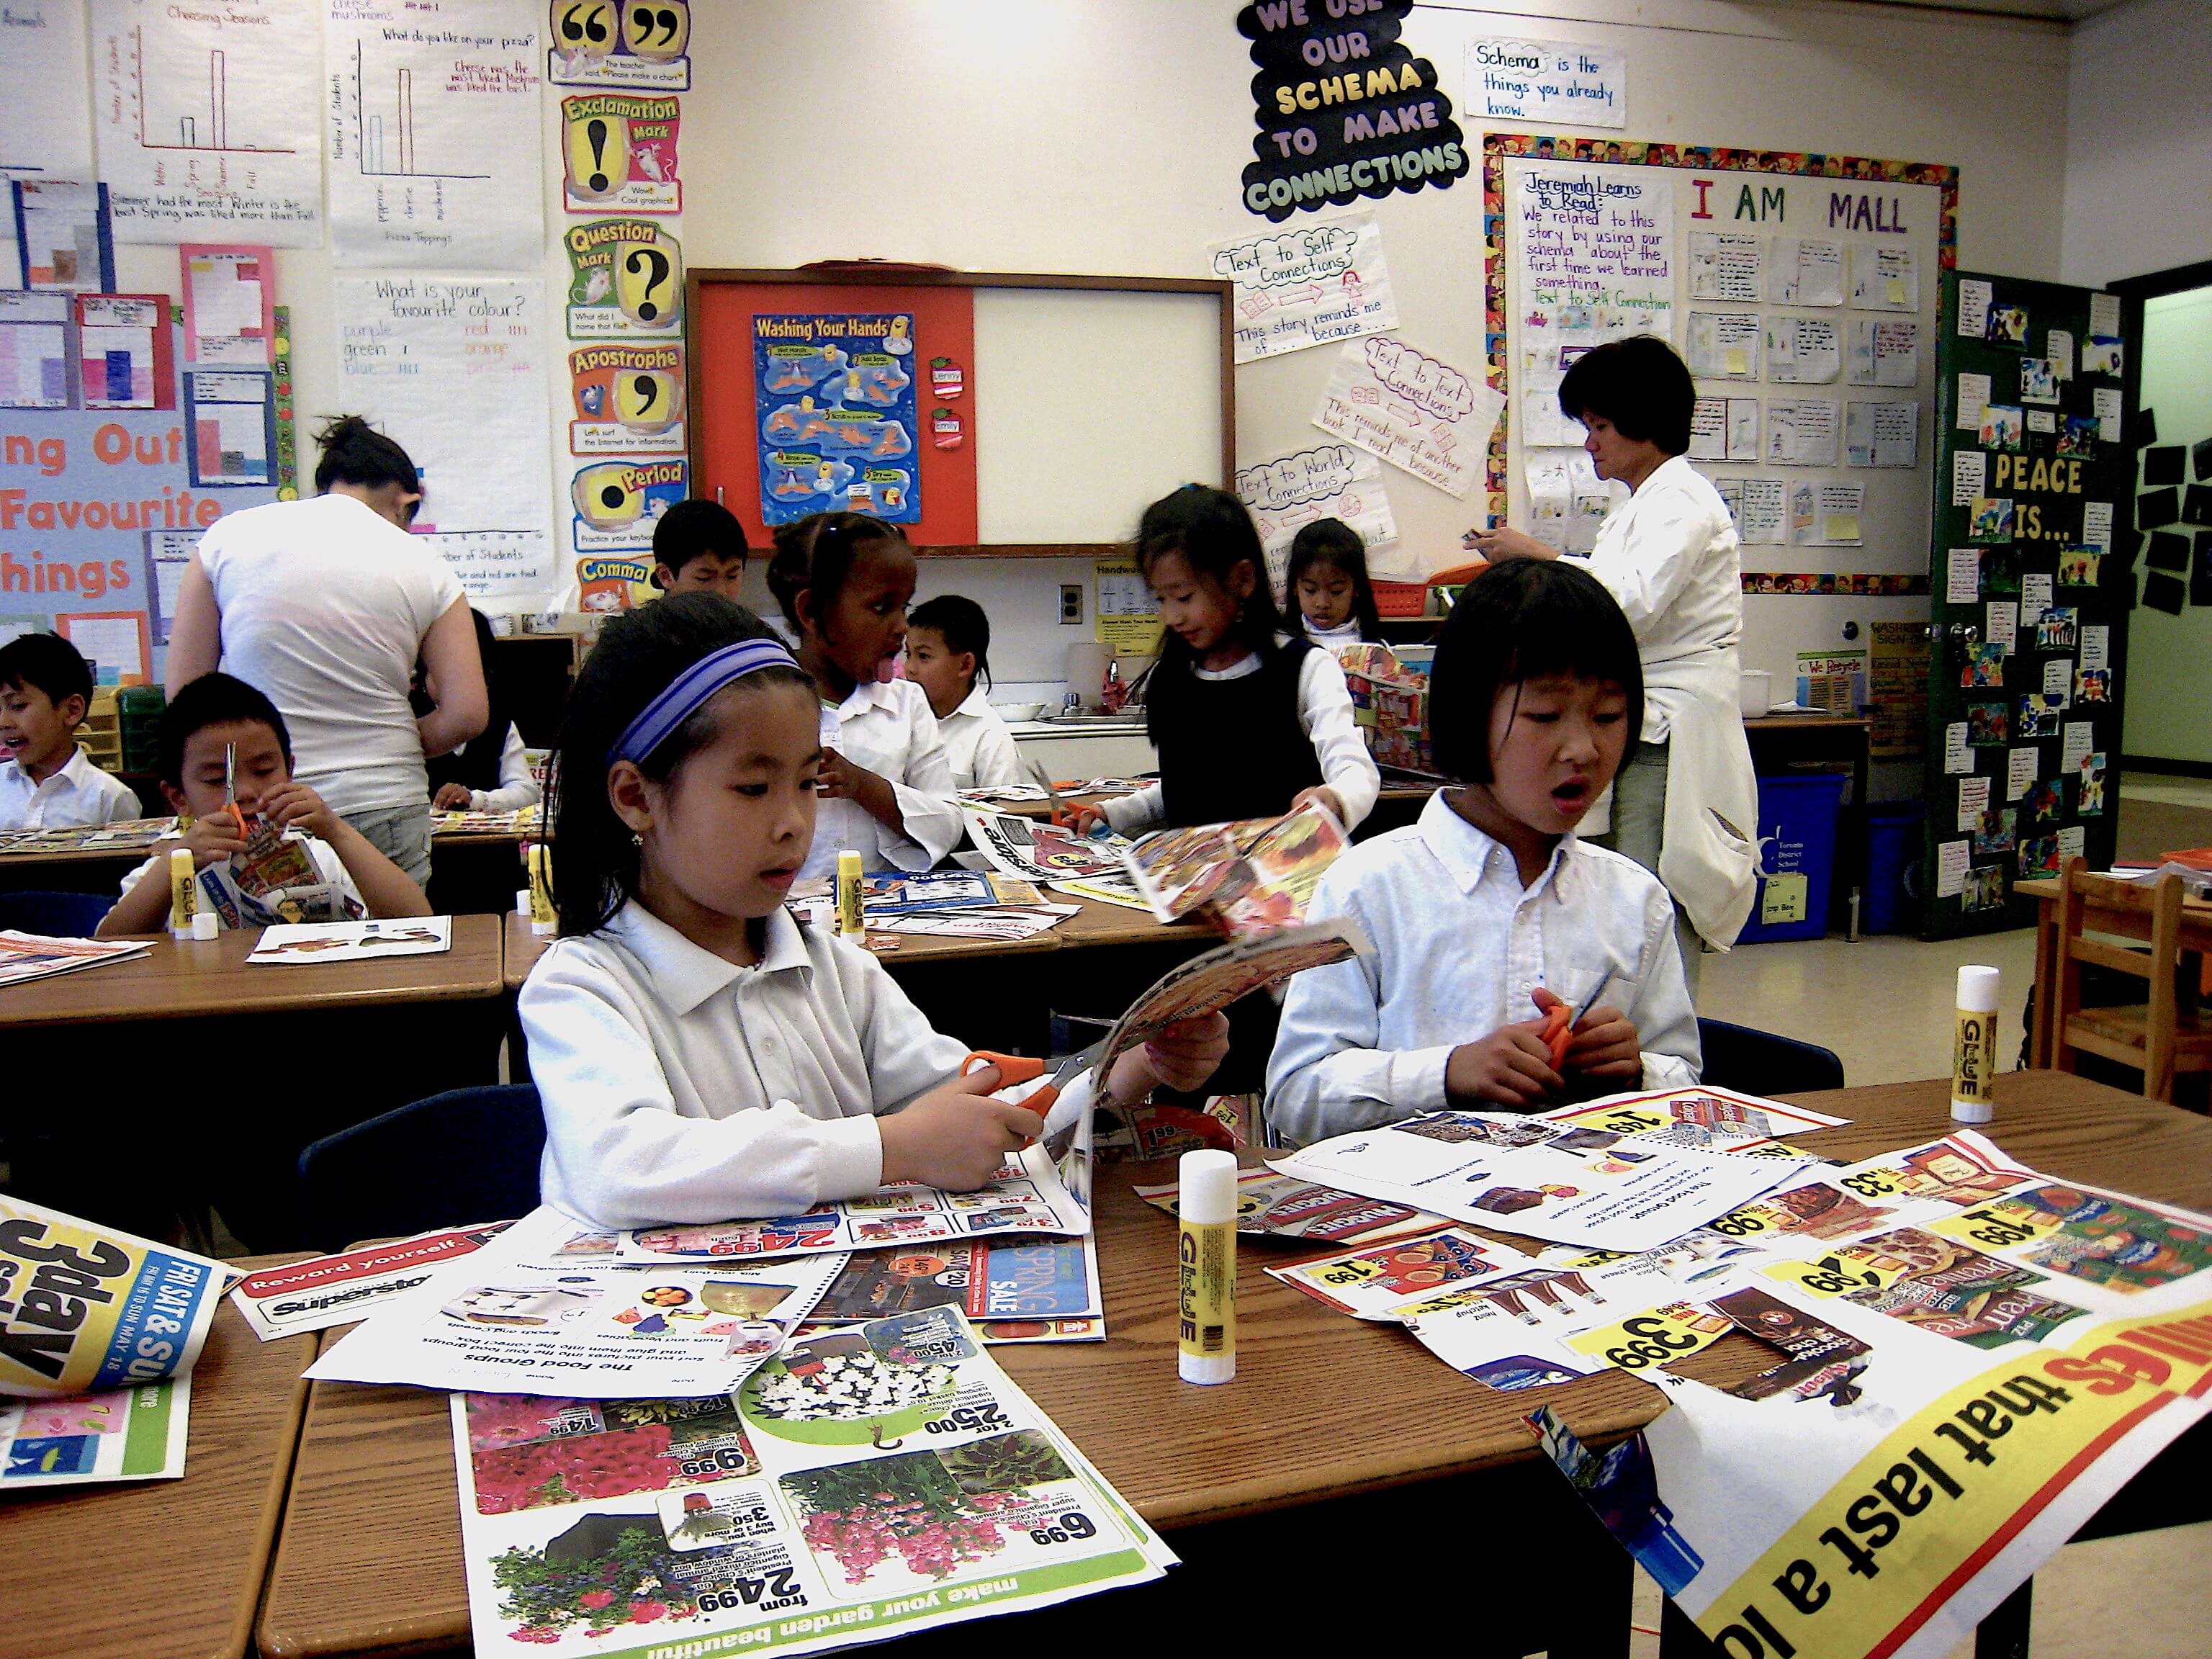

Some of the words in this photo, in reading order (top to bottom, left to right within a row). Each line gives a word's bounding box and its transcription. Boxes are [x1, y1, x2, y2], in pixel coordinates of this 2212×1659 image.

[1256, 0, 1309, 32] WE
[383, 28, 408, 41] What
[412, 30, 425, 42] do
[426, 33, 441, 45] you
[1302, 32, 1370, 66] OUR
[1477, 45, 1539, 70] Schema
[1557, 58, 1569, 71] is
[1578, 55, 1599, 73] the
[1276, 63, 1422, 114] SCHEMA
[1484, 72, 1529, 99] things
[1537, 84, 1559, 102] you
[1567, 80, 1614, 107] already
[565, 96, 678, 121] Exclamation
[633, 125, 670, 142] Mark
[1272, 127, 1318, 158] TO
[1344, 102, 1439, 143] MAKE
[1246, 142, 1462, 211] CONNECTIONS
[1525, 172, 1595, 194] Jeremiah
[1596, 175, 1642, 195] Learns
[1538, 192, 1552, 208] to
[1691, 179, 1714, 220] I
[1734, 184, 1786, 222] AM
[1828, 192, 1907, 234] MALL
[1522, 204, 1542, 222] We
[1552, 210, 1601, 226] related
[1611, 212, 1627, 228] to
[1629, 210, 1655, 229] this
[570, 220, 657, 253] Question
[1527, 228, 1563, 243] story
[1573, 225, 1588, 249] by
[1596, 233, 1636, 251] using
[1642, 235, 1663, 246] our
[576, 251, 613, 269] Mark
[1221, 248, 1262, 273] Text
[1276, 244, 1294, 264] to
[1303, 233, 1337, 257] Self
[1527, 242, 1574, 257] schema
[1590, 244, 1631, 261] about
[1637, 246, 1662, 261] the
[1260, 254, 1346, 282] Connections
[1527, 255, 1559, 272] first
[1563, 257, 1591, 274] time
[1597, 264, 1614, 275] we
[1620, 260, 1668, 278] learned
[376, 279, 416, 300] What
[425, 283, 439, 299] is
[445, 284, 485, 305] your
[390, 297, 457, 318] favourite
[469, 295, 526, 318] colour?
[465, 318, 490, 336] red
[757, 318, 814, 342] Washing
[816, 318, 846, 338] Your
[848, 318, 890, 338] Hands
[1235, 327, 1267, 342] This
[1273, 315, 1308, 334] story
[1313, 302, 1360, 325] reminds
[1363, 300, 1382, 313] me
[343, 343, 387, 362] green
[574, 349, 680, 375] Apostrophe
[1373, 343, 1401, 369] Text
[1413, 364, 1426, 385] to
[1436, 373, 1467, 403] Text
[1386, 369, 1452, 418] Connections
[1328, 397, 1351, 419] This
[1322, 411, 1345, 431] book
[92, 422, 184, 464] Out
[622, 462, 683, 494] Period
[1234, 469, 1271, 495] Text
[1279, 465, 1296, 483] to
[1303, 449, 1346, 475] World
[1995, 453, 2083, 494] PEACE
[1267, 475, 1339, 503] Connections
[0, 485, 222, 530] Favourite
[2014, 504, 2069, 541] IS...
[580, 560, 649, 583] Comma
[1808, 660, 1824, 674] We
[1825, 657, 1861, 675] Recycle
[1961, 1020, 1981, 1096] GLUE
[1304, 1205, 1409, 1236] HUGGIES
[1961, 1210, 2035, 1247] 199
[163, 1259, 202, 1285] FRI
[250, 1263, 352, 1290] Reward
[358, 1238, 466, 1270] yourself.
[1015, 1246, 1059, 1312] SPRING
[1181, 1231, 1197, 1342] GLUE
[156, 1282, 193, 1319] SAT
[989, 1280, 1018, 1313] SALE
[1455, 1304, 1491, 1319] ketchup
[1473, 1310, 1498, 1322] heinz
[446, 1322, 493, 1332] Cereals
[114, 1324, 136, 1354] MAY
[421, 1336, 469, 1348] groups
[478, 1339, 528, 1348] correct
[582, 1345, 621, 1354] them
[1604, 1317, 1699, 1370] 399
[463, 1353, 536, 1367] Groups
[540, 1358, 591, 1370] Food
[559, 1350, 583, 1359] into
[588, 1350, 641, 1362] pictures
[598, 1362, 634, 1372] The
[953, 1390, 992, 1402] Gigantico
[956, 1385, 989, 1396] hanging
[925, 1398, 953, 1408] deluxe
[951, 1395, 996, 1410] President's
[975, 1424, 999, 1434] for
[1001, 1420, 1015, 1429] 2
[1934, 1375, 2073, 1469] that
[1007, 1502, 1050, 1514] Gigantico
[1030, 1503, 1082, 1519] President's
[1051, 1497, 1076, 1507] super
[1818, 1445, 1966, 1581] last
[755, 1520, 774, 1529] buy
[969, 1509, 1006, 1521] annuals
[703, 1529, 731, 1538] more
[727, 1531, 747, 1541] you
[748, 1527, 777, 1537] when
[693, 1556, 732, 1568] window
[712, 1563, 742, 1573] mixed
[737, 1558, 792, 1577] President's
[742, 1552, 790, 1568] Gigantico
[675, 1568, 711, 1579] annual
[946, 1577, 1019, 1604] make
[1772, 1558, 1833, 1617] a
[757, 1595, 809, 1613] from
[881, 1589, 944, 1618] your
[780, 1601, 875, 1635] garden
[647, 1622, 772, 1658] beautiful
